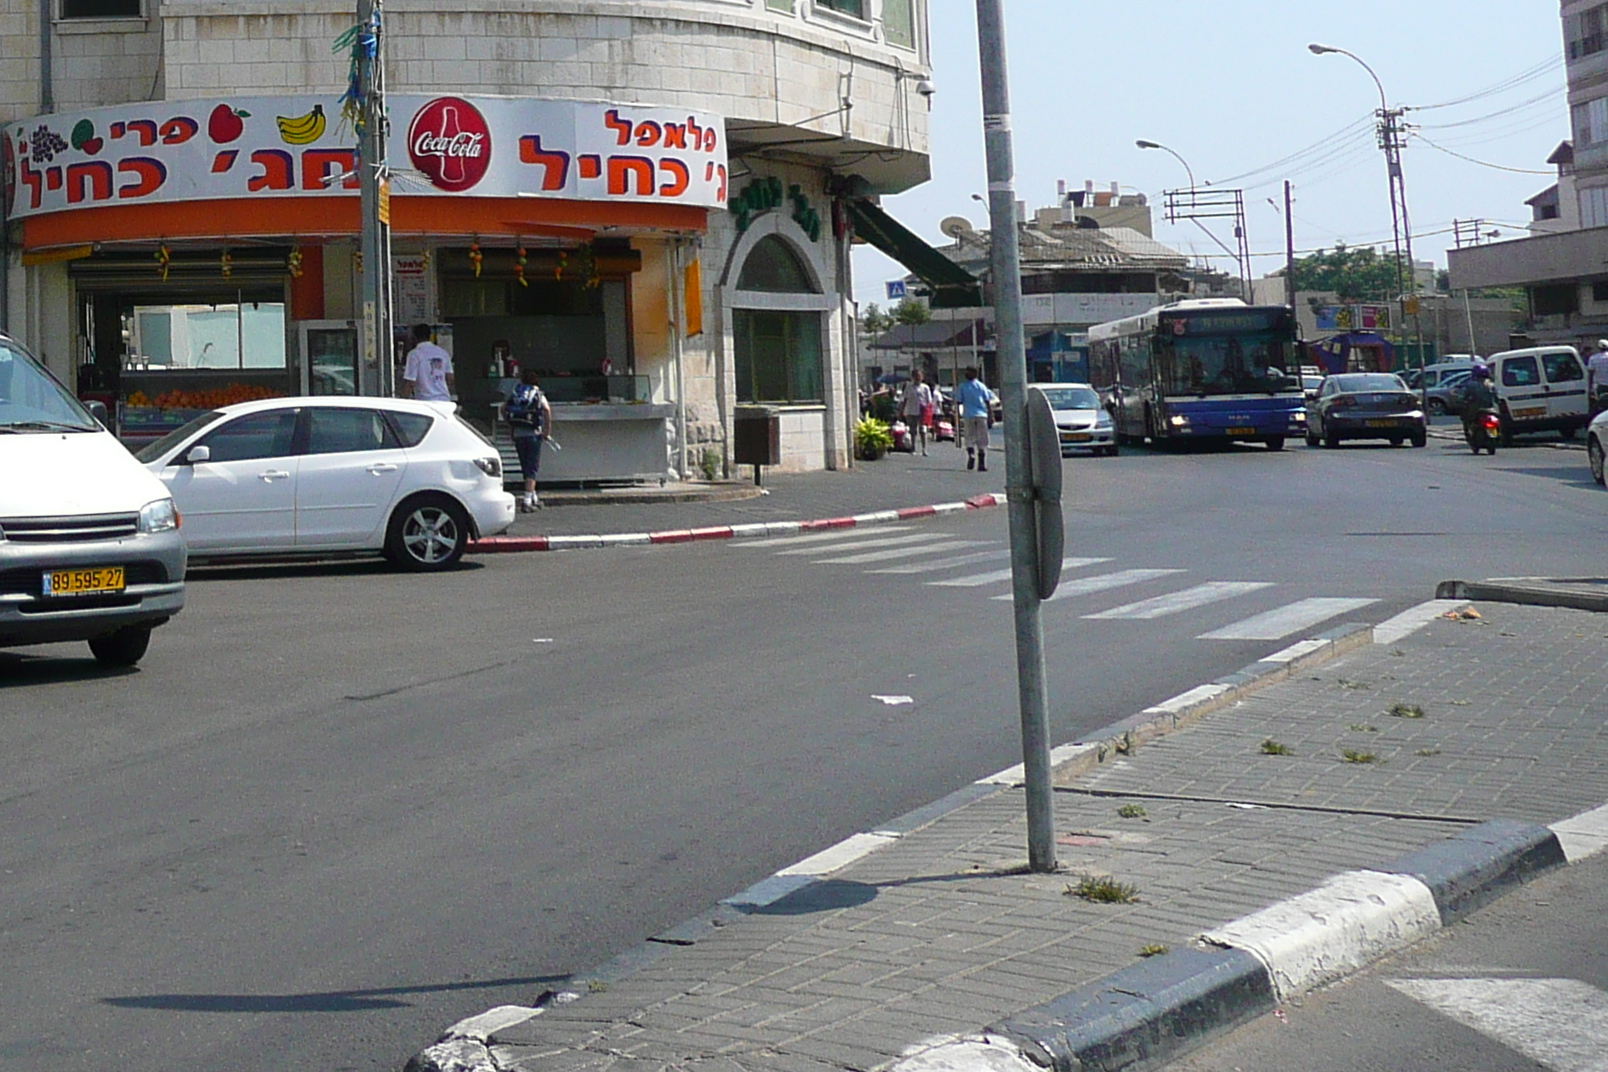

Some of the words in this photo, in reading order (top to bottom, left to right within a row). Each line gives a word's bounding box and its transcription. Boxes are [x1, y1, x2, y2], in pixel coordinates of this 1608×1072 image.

[110, 116, 199, 146] פרי
[415, 131, 484, 157] Coca-Cola
[604, 109, 717, 152] פלאפל
[21, 157, 167, 209] כחיל
[519, 135, 690, 196] כחיל
